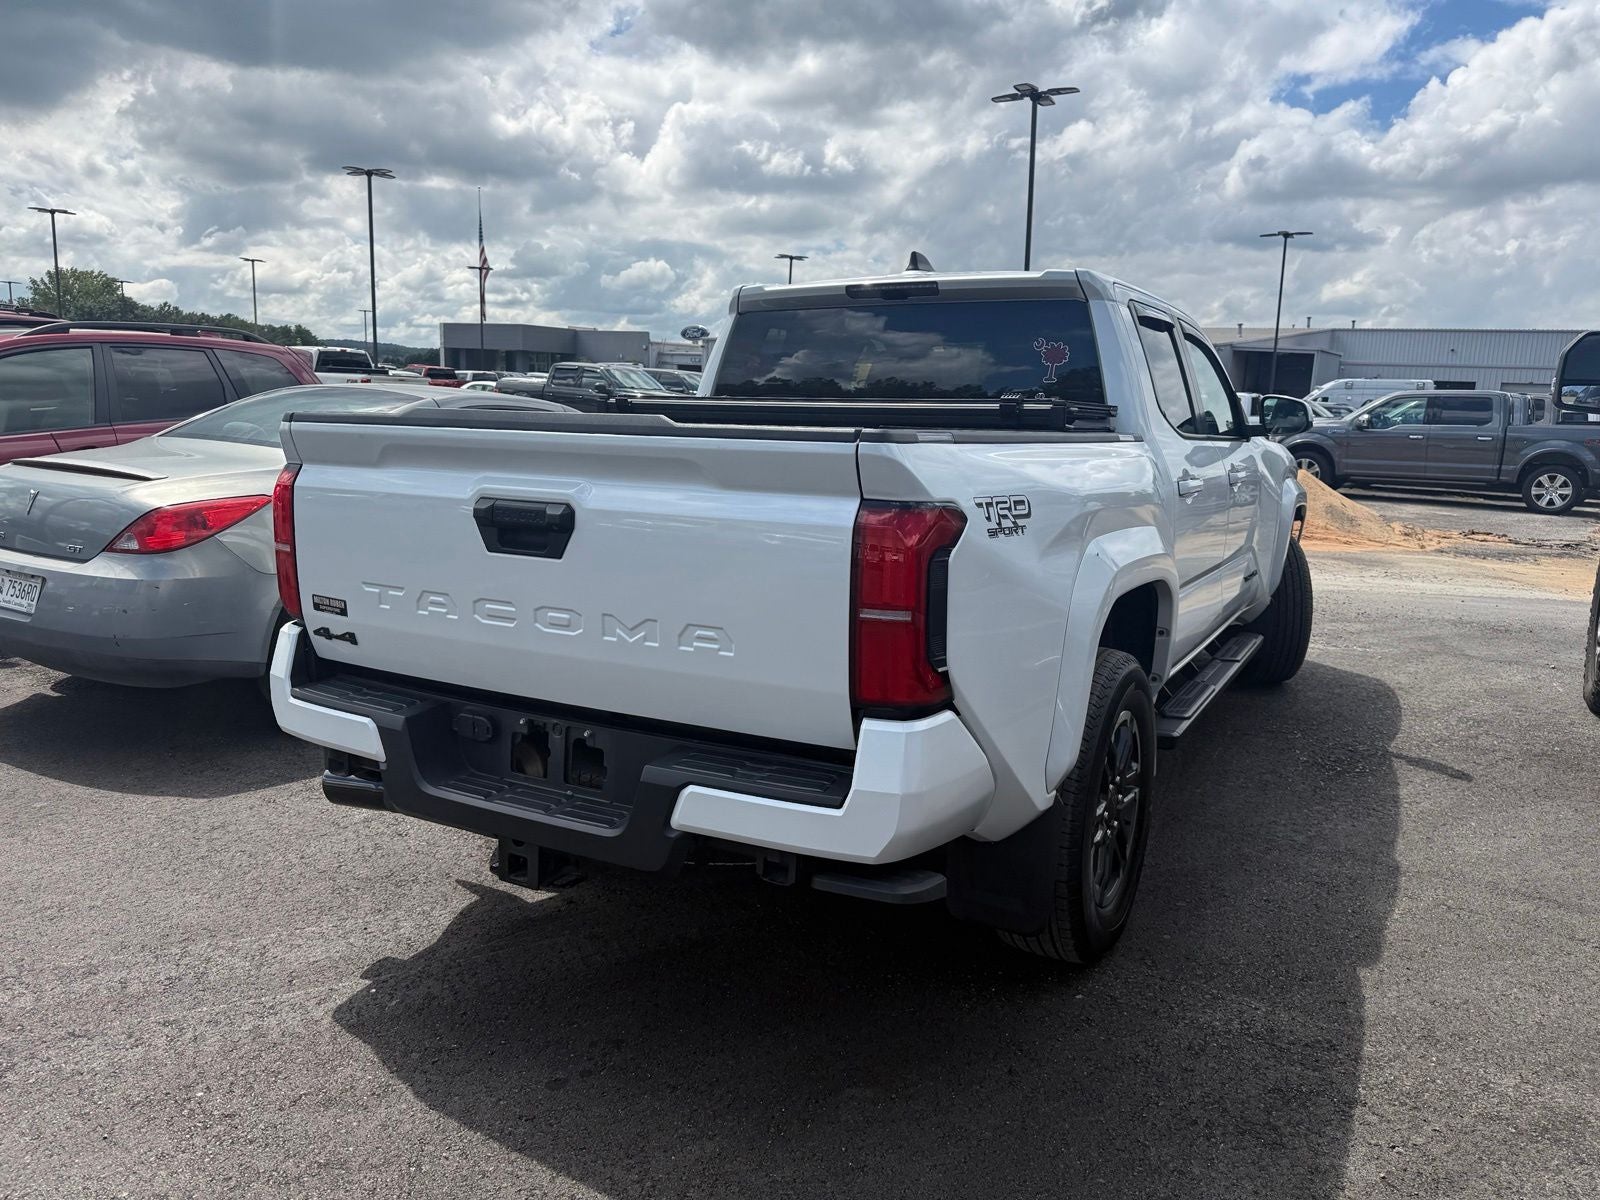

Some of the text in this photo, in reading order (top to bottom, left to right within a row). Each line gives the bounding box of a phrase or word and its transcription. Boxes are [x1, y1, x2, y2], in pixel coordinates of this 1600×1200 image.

[973, 494, 1032, 527] TRD
[986, 525, 1027, 539] SPORT
[66, 544, 84, 553] GT
[361, 581, 735, 657] TACOMA
